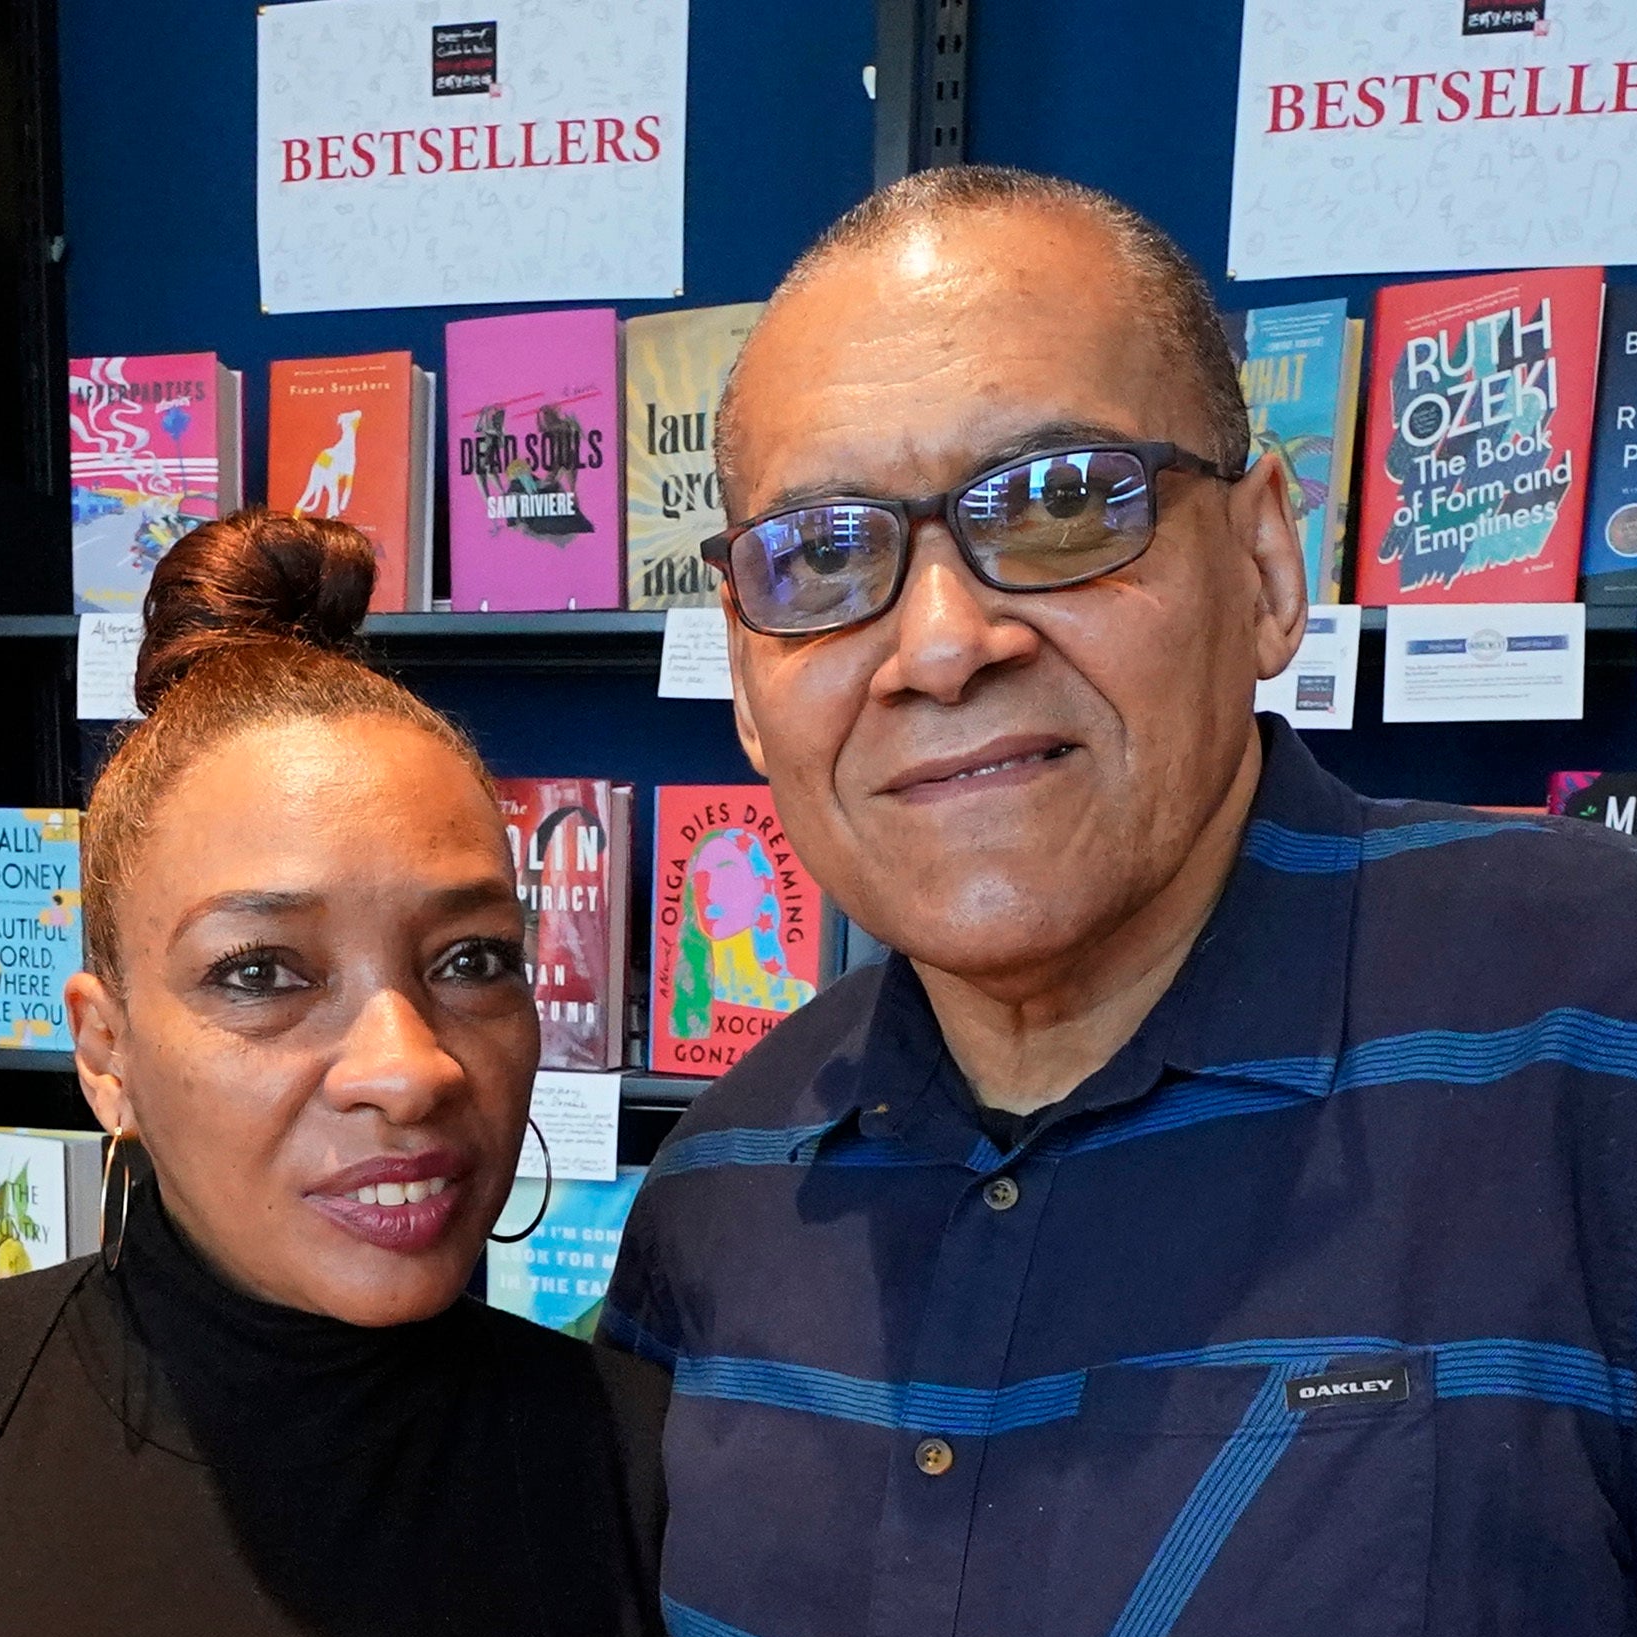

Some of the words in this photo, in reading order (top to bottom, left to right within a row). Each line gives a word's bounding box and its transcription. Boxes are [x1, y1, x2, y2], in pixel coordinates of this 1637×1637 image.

[281, 115, 661, 183] BESTSELLERS
[1407, 298, 1551, 389] RUTH
[1402, 357, 1557, 447] OZEKI
[460, 435, 517, 475] DEAD
[525, 430, 603, 472] SOULS
[1476, 428, 1552, 469] Book
[487, 495, 517, 519] SAM
[521, 492, 575, 518] RIVIERE
[1431, 482, 1505, 514] Form
[1414, 499, 1558, 555] Emptiness
[661, 858, 686, 925] OLGA
[680, 803, 731, 843] DIES
[744, 805, 804, 943] DREAMING
[21, 1003, 62, 1026] YOU
[1299, 1379, 1394, 1399] OAKLEY
